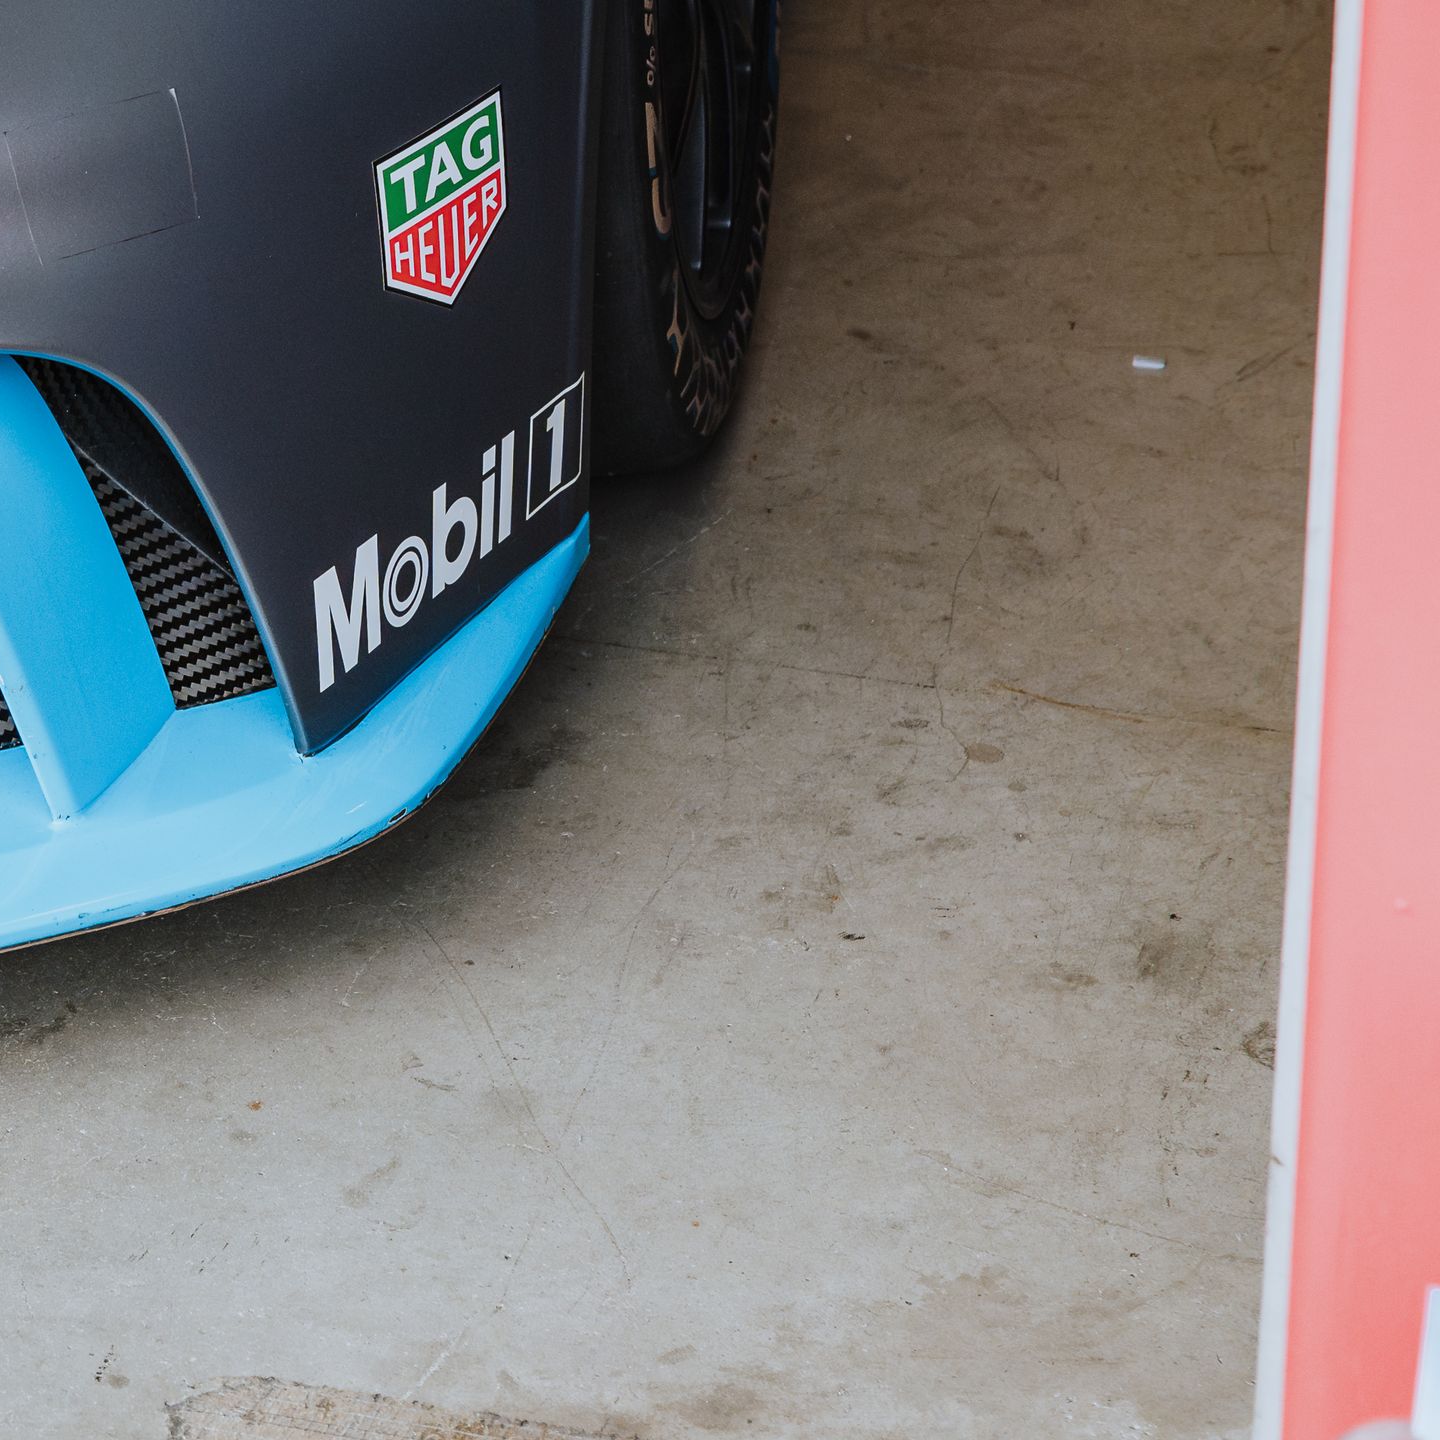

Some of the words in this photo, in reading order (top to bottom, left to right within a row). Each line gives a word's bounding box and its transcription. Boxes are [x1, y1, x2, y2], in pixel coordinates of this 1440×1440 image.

[389, 114, 493, 214] TAG
[393, 177, 499, 289] HEUER
[313, 429, 515, 693] Mobil
[545, 398, 567, 493] 1
